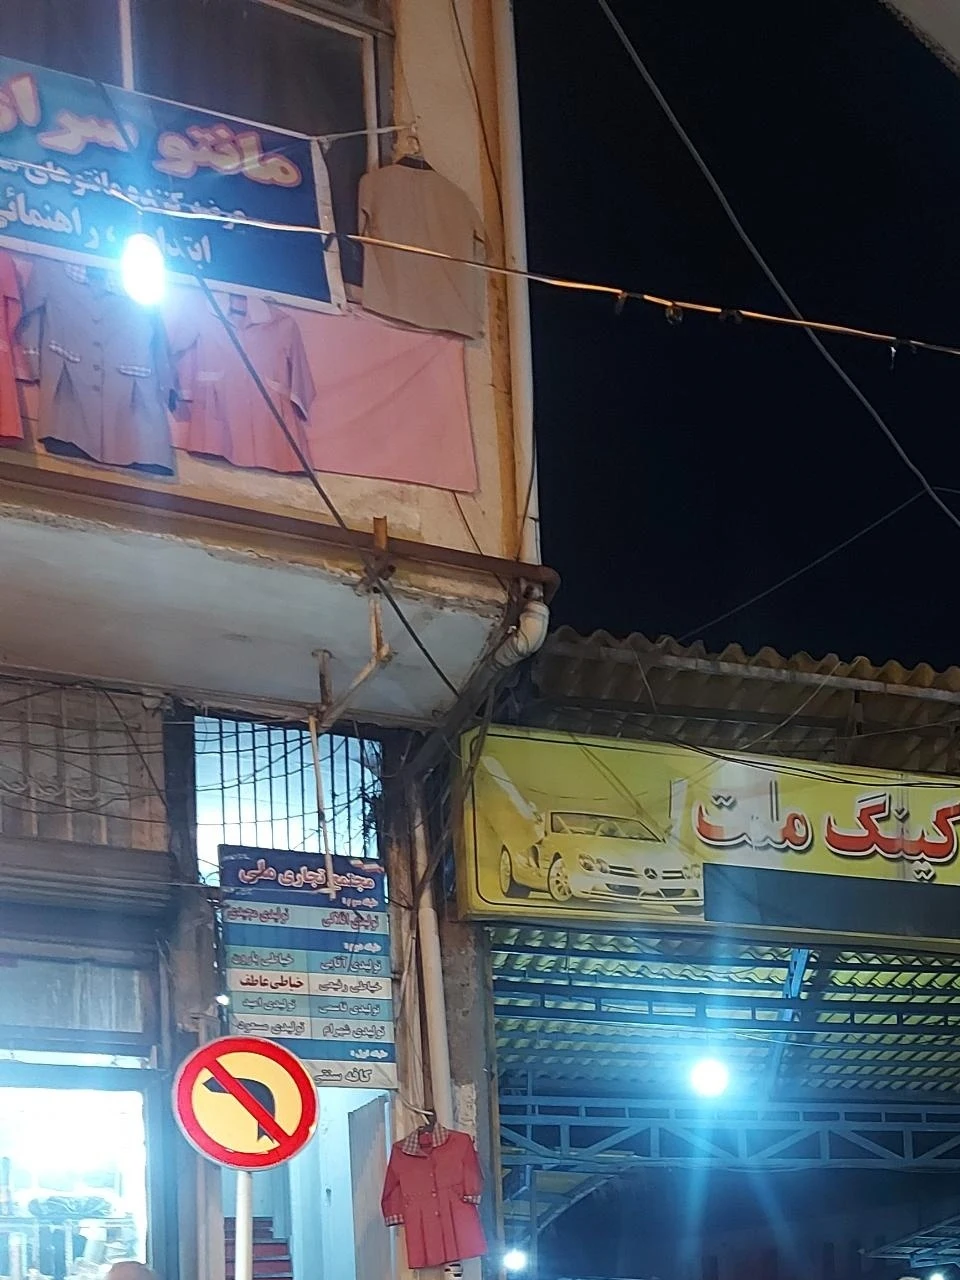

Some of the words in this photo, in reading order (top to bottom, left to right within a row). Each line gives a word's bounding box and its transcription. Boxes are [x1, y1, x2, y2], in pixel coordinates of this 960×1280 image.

[153, 123, 302, 188] مانتو
[694, 780, 814, 852] ملت
[238, 858, 277, 884] ملی
[277, 866, 327, 888] تجاری
[259, 906, 290, 925] تولیدی
[350, 914, 380, 931] تولیدی
[260, 951, 295, 968] خیاطی
[350, 958, 382, 975] تولیدی
[239, 973, 270, 988] عاطف
[270, 975, 304, 992] خیاطی
[349, 979, 382, 995] خیاطی
[263, 997, 296, 1013] تولیدی
[349, 1002, 381, 1017] تولیدی
[270, 1019, 306, 1035] تولیدی
[352, 1022, 386, 1040] تولیدی
[345, 1067, 373, 1083] کافه
